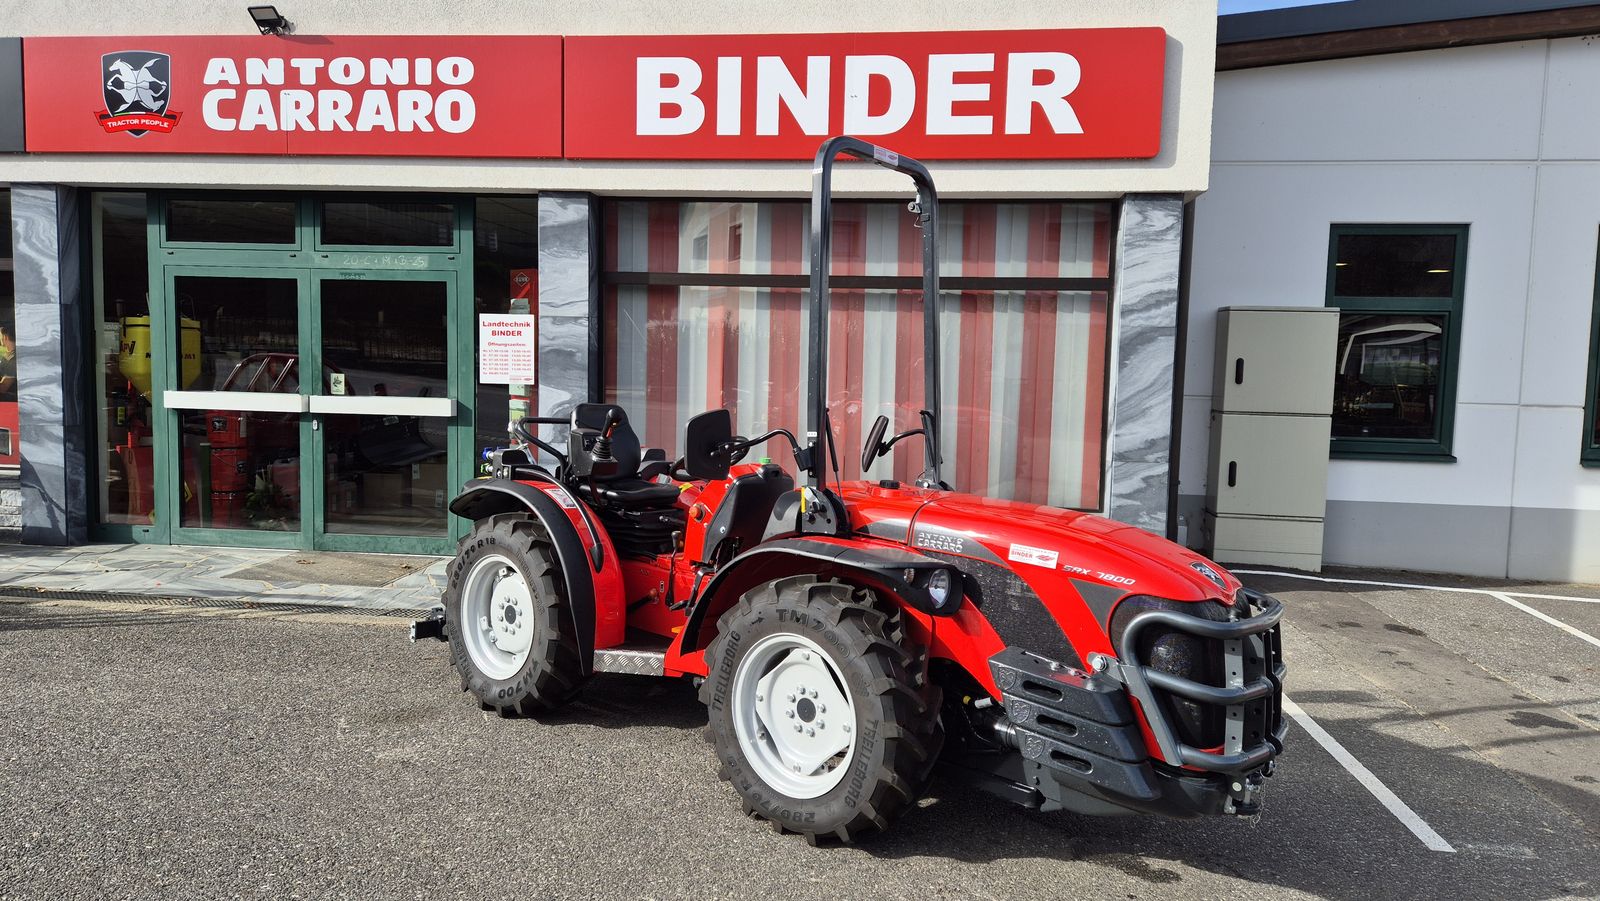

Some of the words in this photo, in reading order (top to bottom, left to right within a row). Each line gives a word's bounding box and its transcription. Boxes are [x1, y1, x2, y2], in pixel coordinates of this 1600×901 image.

[203, 56, 476, 86] ANTONIO
[636, 52, 1084, 136] BINDER
[202, 89, 476, 134] CARRARO
[107, 119, 139, 128] TRACTOR
[140, 119, 169, 128] PEOPLE
[482, 320, 531, 328] Landtechnik
[917, 538, 963, 553] CARRARO
[919, 532, 964, 545] ANTONIO
[1010, 550, 1034, 559] BINDER
[1062, 564, 1092, 576] SRX
[1096, 571, 1137, 586] 7800
[712, 629, 742, 713] TRELLEBORG
[845, 718, 880, 809] TRELLEBORG
